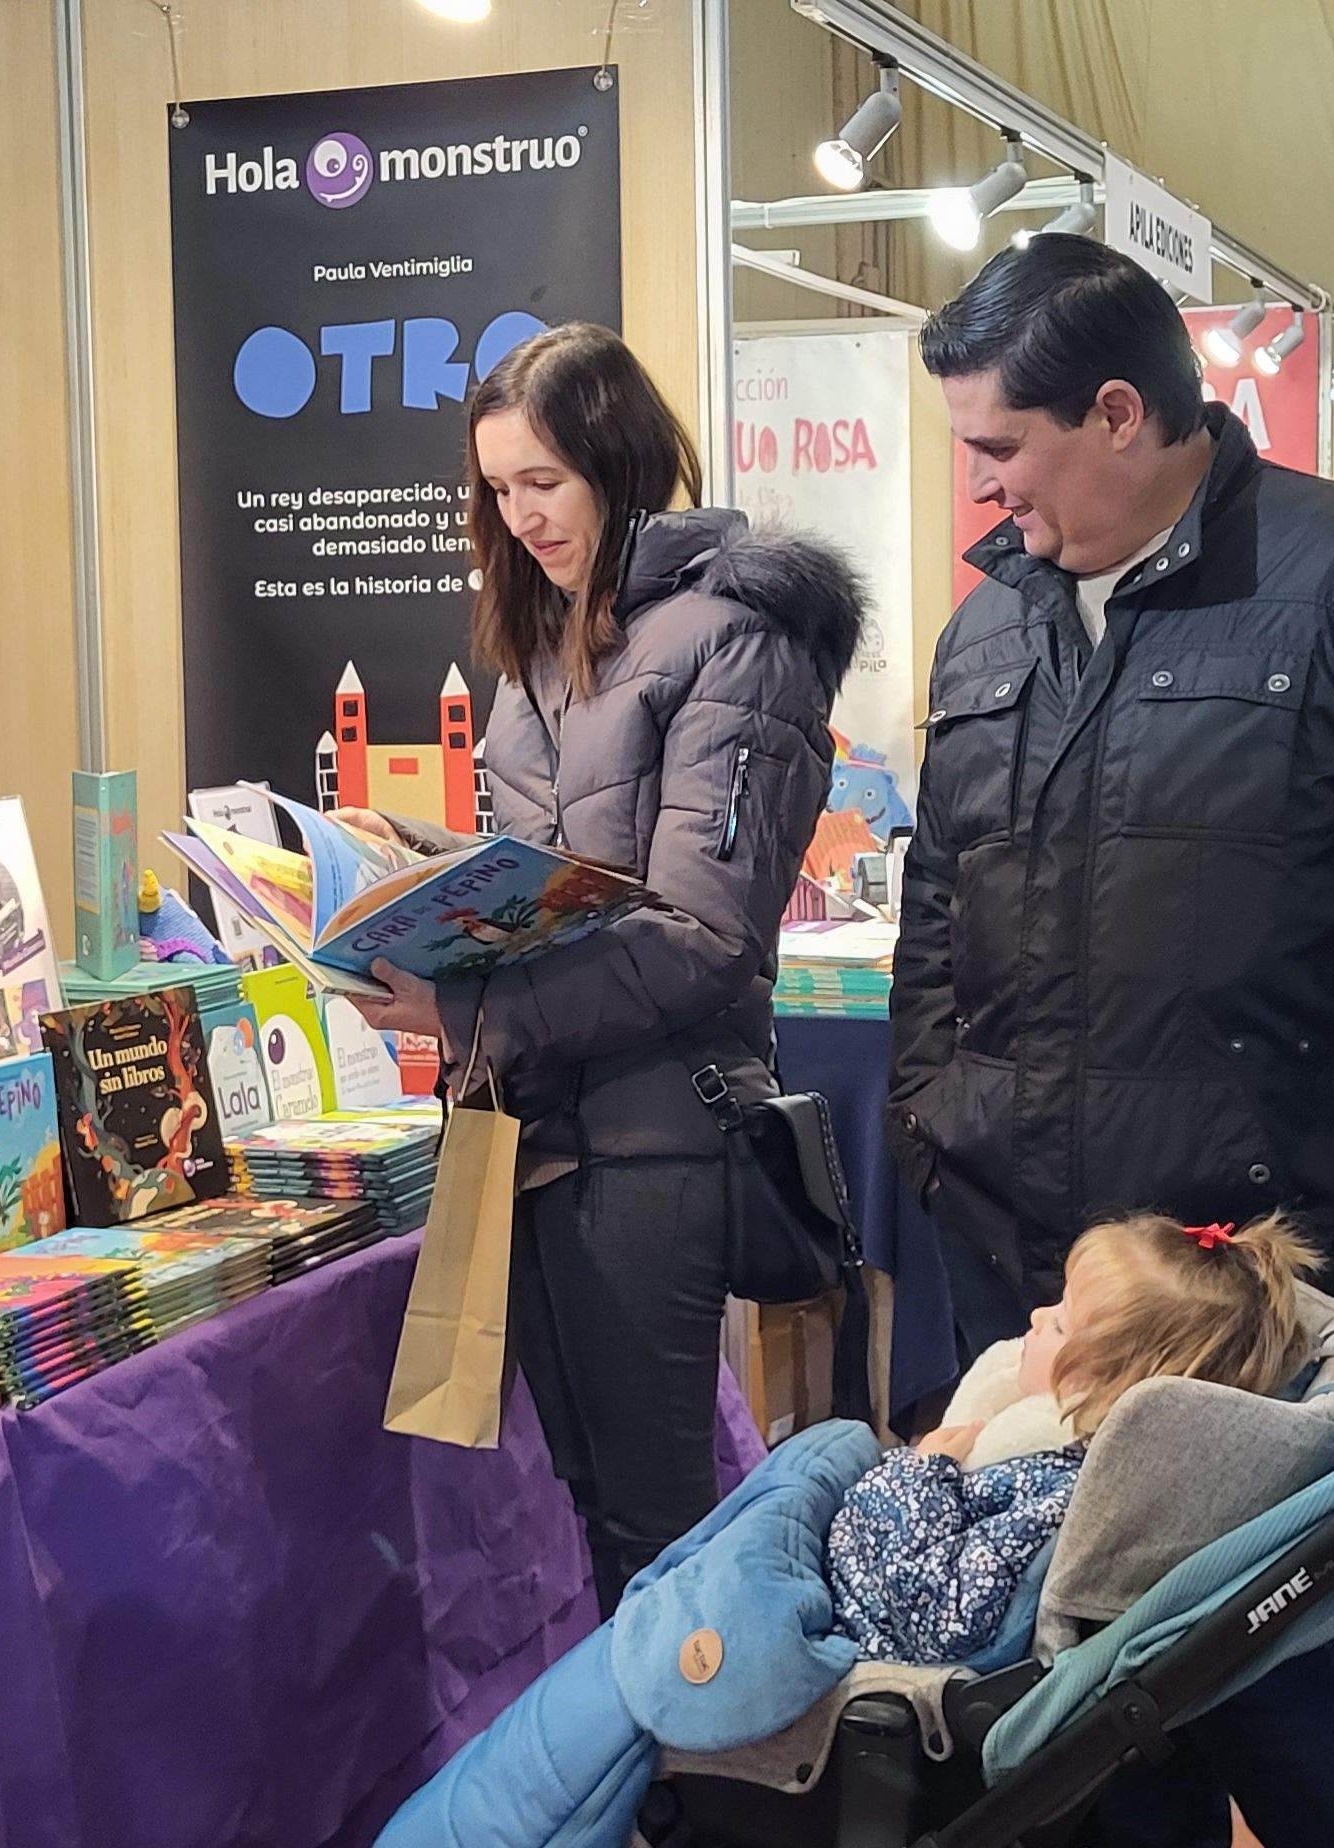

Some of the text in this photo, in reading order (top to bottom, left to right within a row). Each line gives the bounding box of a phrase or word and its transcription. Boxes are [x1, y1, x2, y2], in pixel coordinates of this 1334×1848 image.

[205, 134, 582, 195] Hola monstruo
[1129, 200, 1194, 274] APILA EDICIONES
[313, 256, 473, 283] Paula Ventimiglia
[735, 368, 789, 402] cción
[736, 417, 878, 475] UO ROSA
[236, 482, 471, 511] Un rey desaparecido, u
[253, 509, 468, 533] casi abandonado y u
[311, 534, 476, 556] demasiado llen
[254, 579, 298, 598] Esta
[301, 581, 326, 597] es
[329, 576, 350, 596] la
[354, 574, 432, 596] historia
[435, 574, 464, 593] de
[351, 914, 417, 952] CARA
[86, 1034, 168, 1071] Un mundo
[98, 1064, 166, 1095] sin libros
[217, 1081, 261, 1120] Lala
